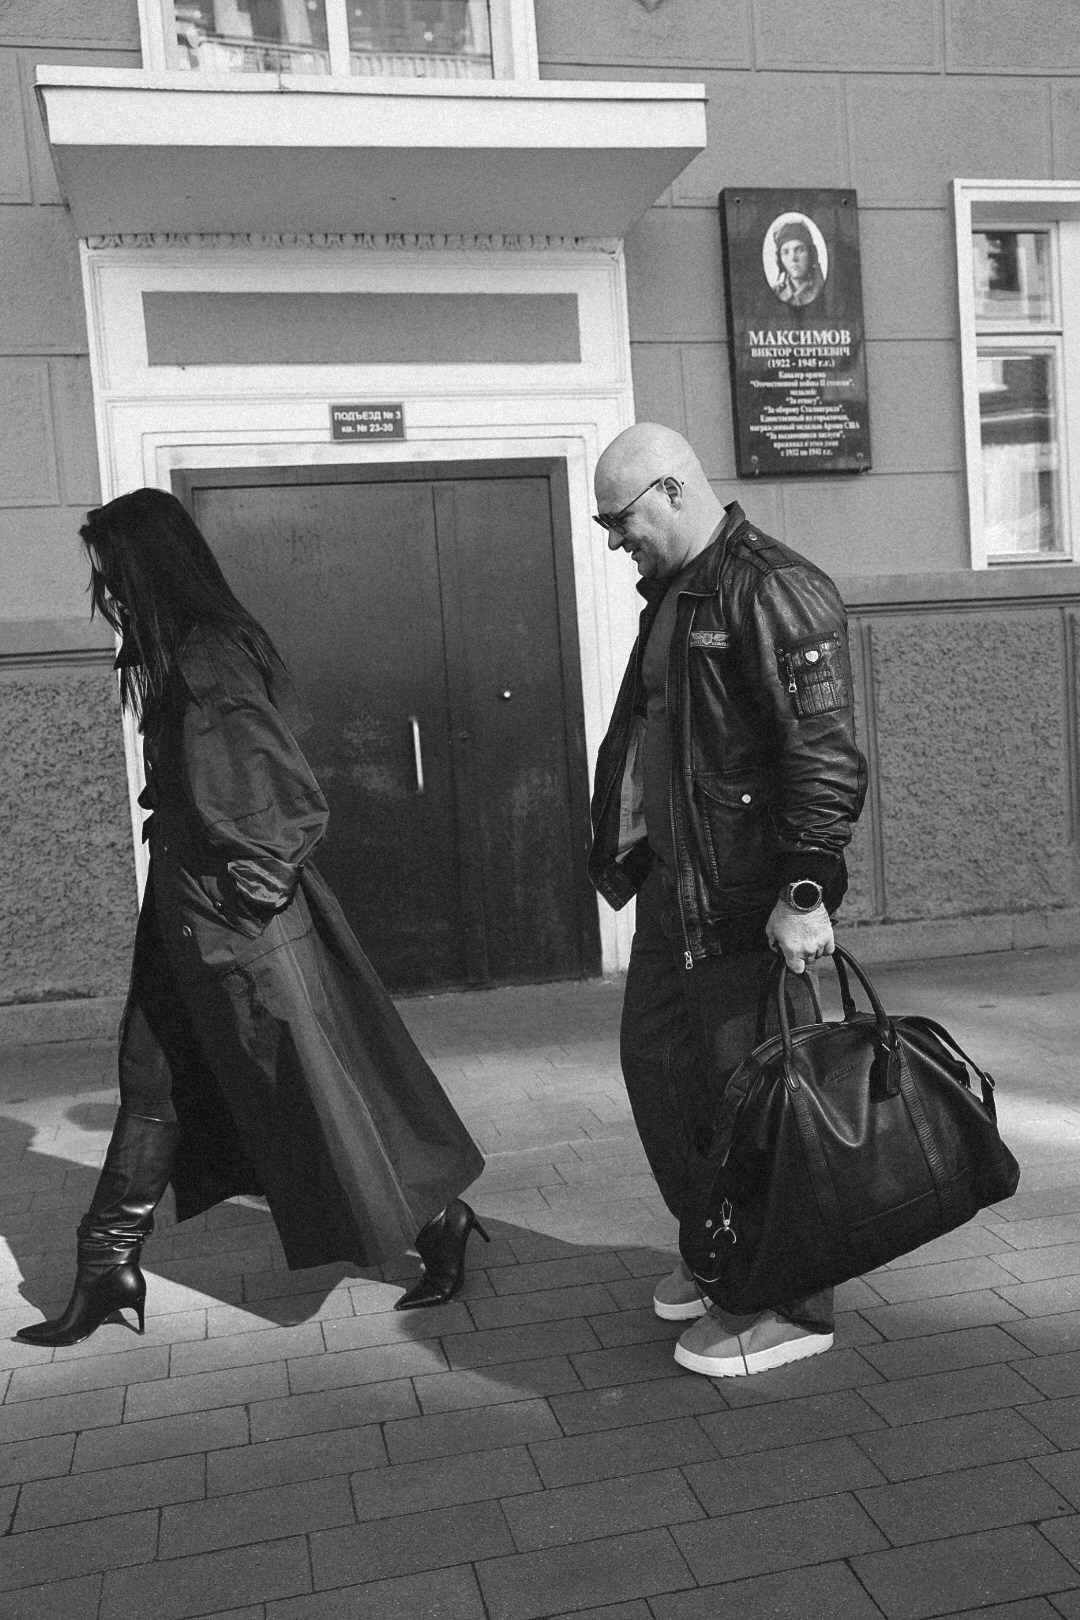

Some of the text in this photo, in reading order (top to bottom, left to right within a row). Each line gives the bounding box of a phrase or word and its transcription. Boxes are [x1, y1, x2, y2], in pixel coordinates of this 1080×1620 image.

[749, 330, 851, 345] МАКСИМОВ
[751, 347, 850, 357] ВИКТОР СЕРГЕЕВИЧ
[334, 411, 401, 422] ПОДЪЕЗД № 3
[357, 424, 368, 433] №
[369, 423, 393, 432] 23-30
